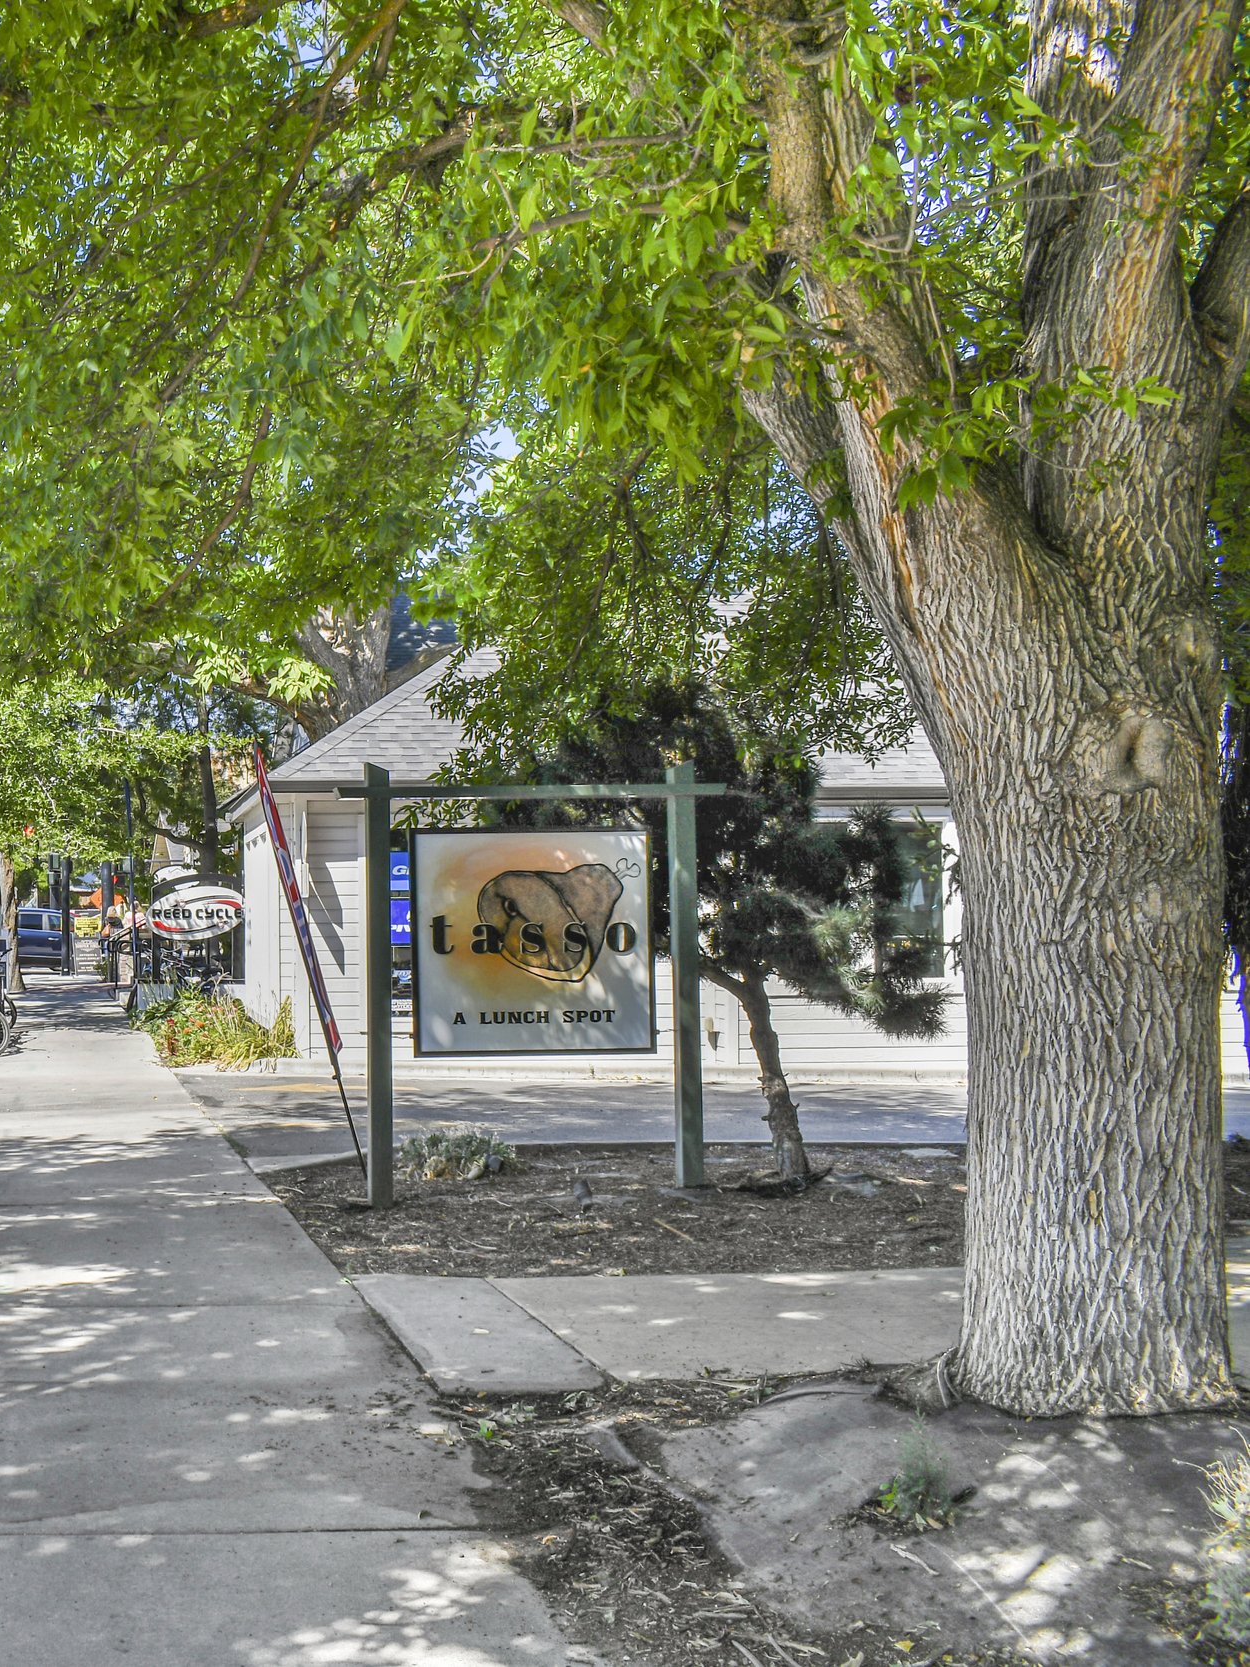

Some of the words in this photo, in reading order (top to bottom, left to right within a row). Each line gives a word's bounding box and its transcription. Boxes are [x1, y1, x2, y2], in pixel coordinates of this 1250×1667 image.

[152, 908, 192, 920] REED
[196, 908, 242, 920] CYCLE
[430, 914, 637, 956] tasso
[453, 1011, 466, 1025] A
[480, 1010, 549, 1025] LUNCH
[562, 1009, 616, 1024] SPOT
